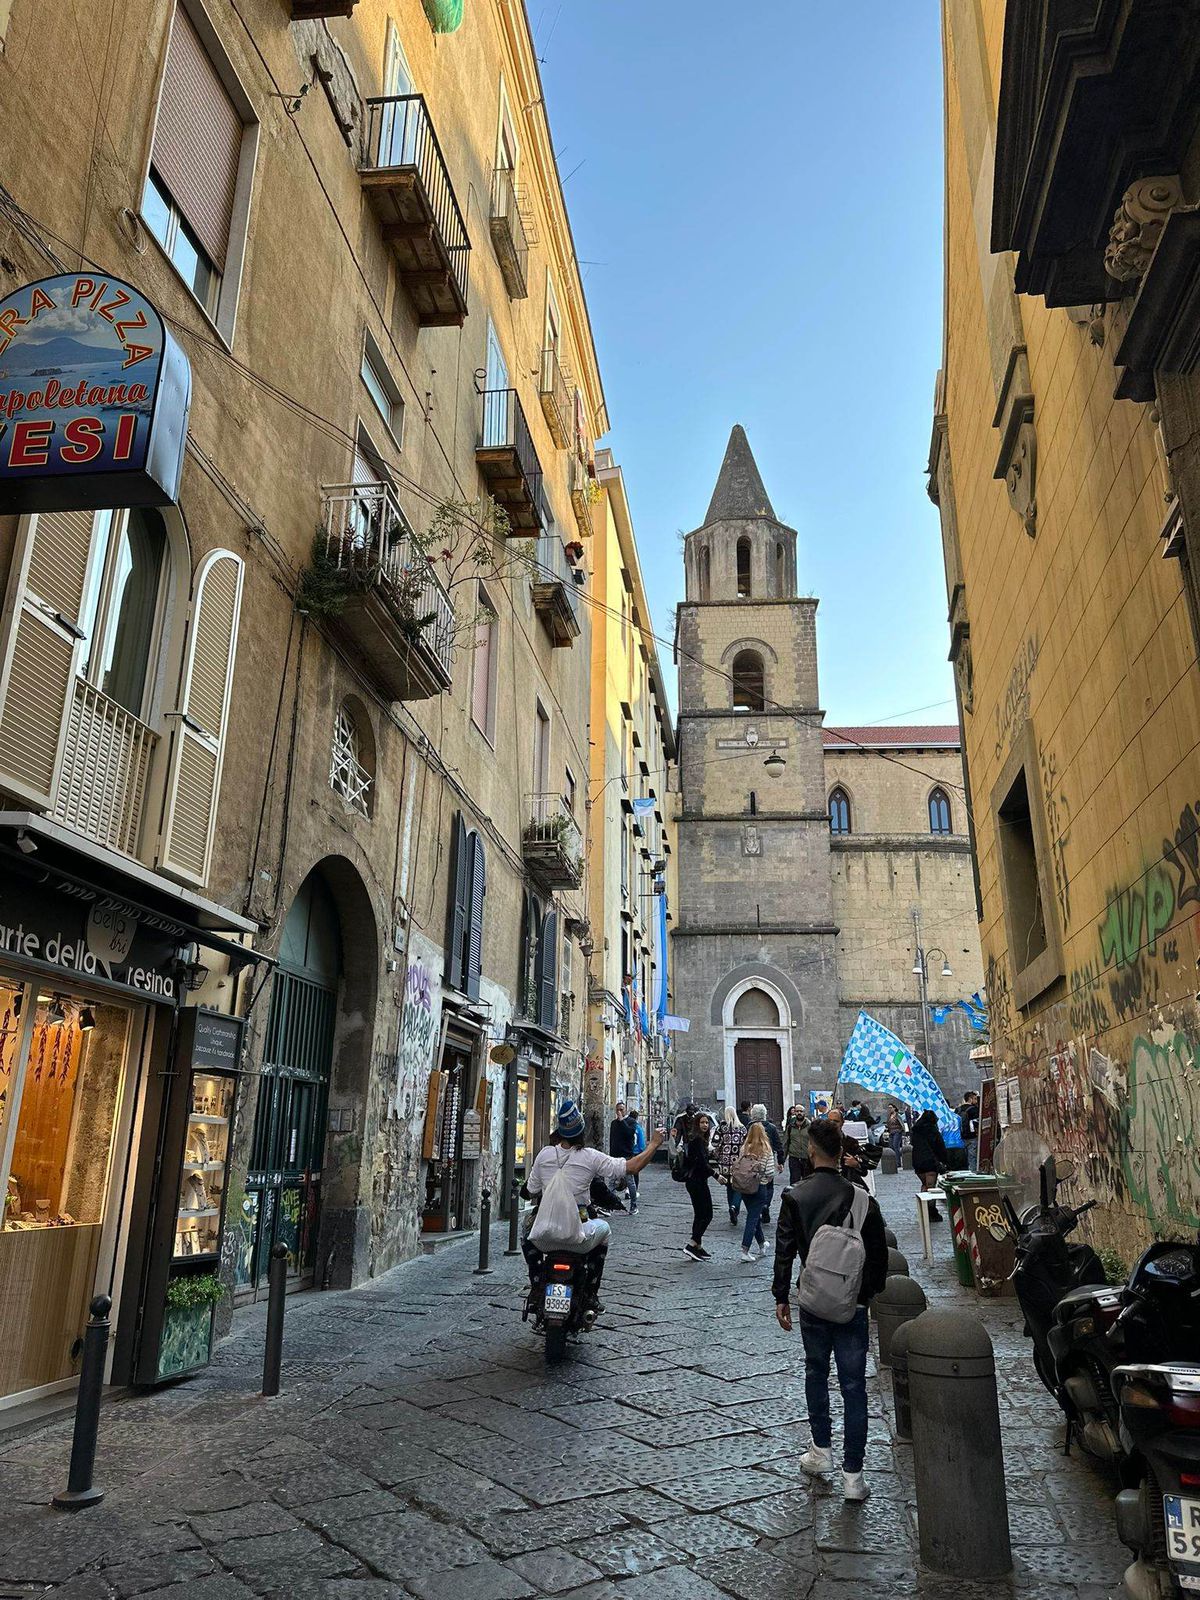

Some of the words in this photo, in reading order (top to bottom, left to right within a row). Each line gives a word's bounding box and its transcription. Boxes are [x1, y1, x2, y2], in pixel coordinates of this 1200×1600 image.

[71, 278, 153, 369] PIZZA
[0, 414, 137, 468] ESI
[46, 932, 97, 974] della
[127, 965, 174, 998] resina
[843, 1062, 889, 1083] SCUSATE
[890, 1076, 901, 1087] IL
[552, 1284, 562, 1296] ES
[546, 1298, 570, 1311] 93855
[1168, 1513, 1183, 1527] PL
